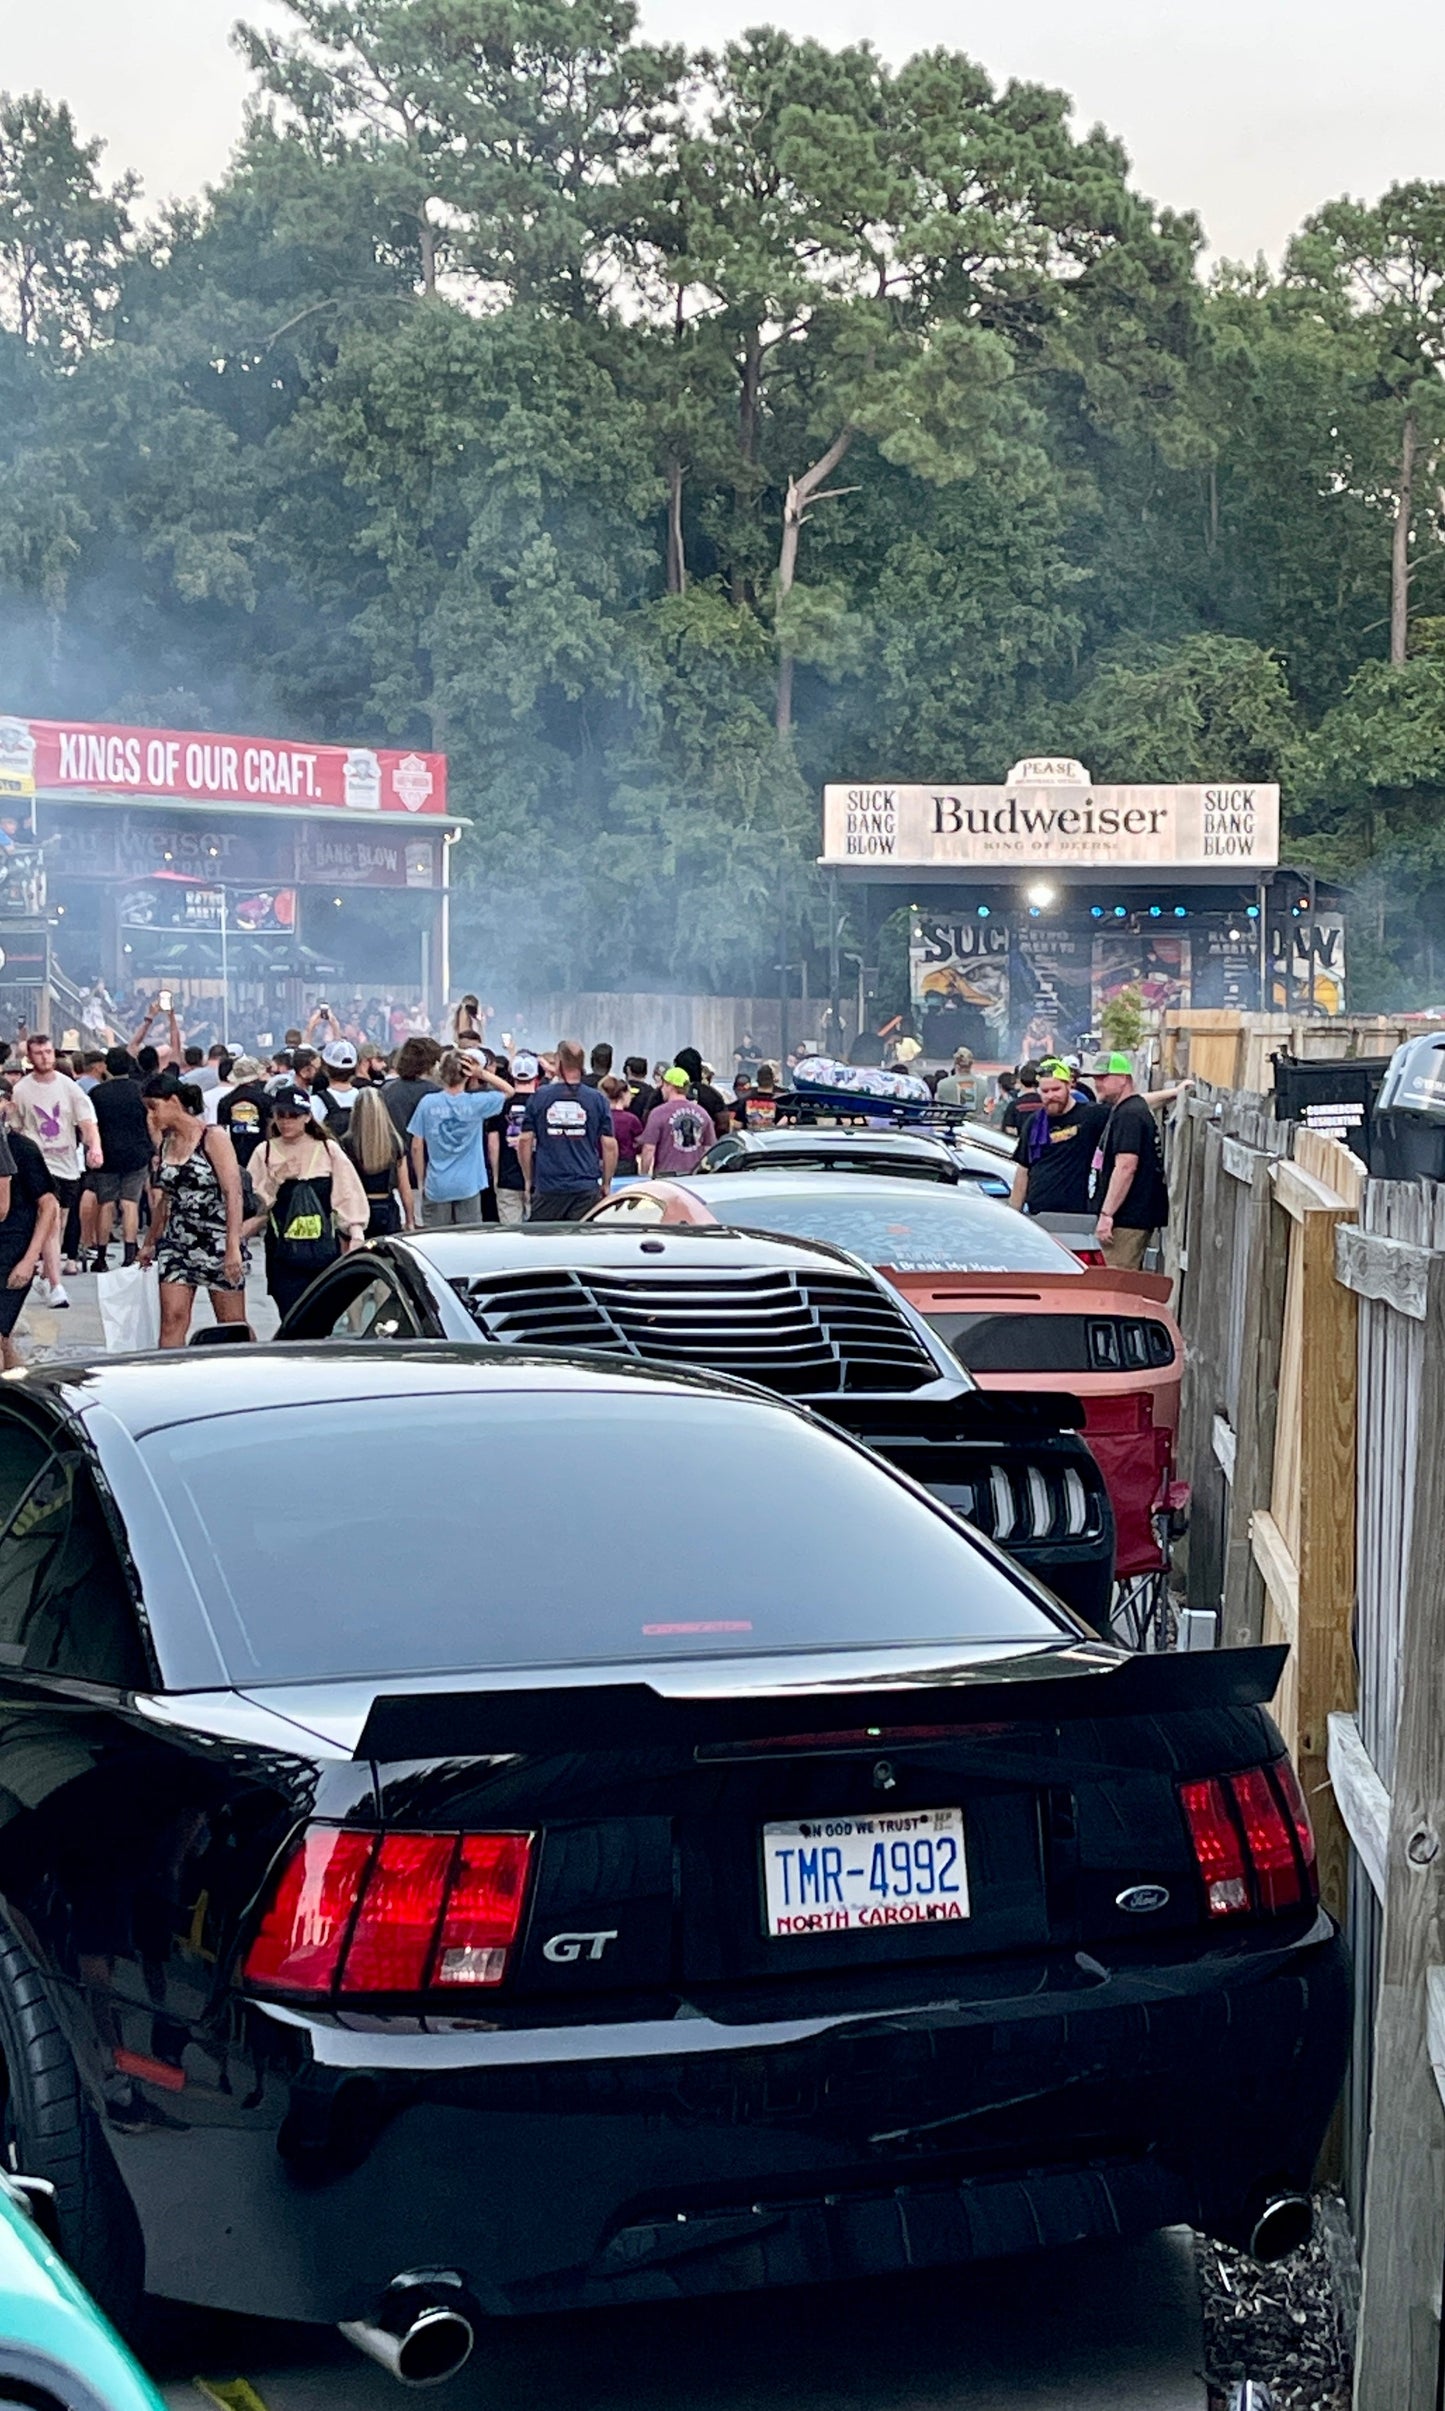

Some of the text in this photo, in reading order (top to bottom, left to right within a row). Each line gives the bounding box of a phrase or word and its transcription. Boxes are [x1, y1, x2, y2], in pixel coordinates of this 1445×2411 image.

[59, 732, 322, 798] KINGS OF OUR CRAFT.
[847, 790, 896, 812] SUCK
[1204, 790, 1257, 812] SUCK
[847, 814, 896, 834] BANG
[930, 796, 1168, 835] Budweiser
[1204, 813, 1255, 834] BANG
[846, 835, 896, 855] BLOW
[983, 841, 1025, 850] KING
[1032, 841, 1050, 850] OF
[1203, 836, 1255, 856] BLOW
[919, 921, 1010, 963] SUC
[945, 1260, 969, 1272] My
[827, 1823, 852, 1838] GOD
[855, 1820, 874, 1835] WE
[879, 1817, 918, 1832] TRUST
[775, 1837, 960, 1906] TMR-4992
[776, 1910, 849, 1934] NORTH
[858, 1901, 962, 1926] CAROLINA
[543, 1930, 618, 1962] GT
